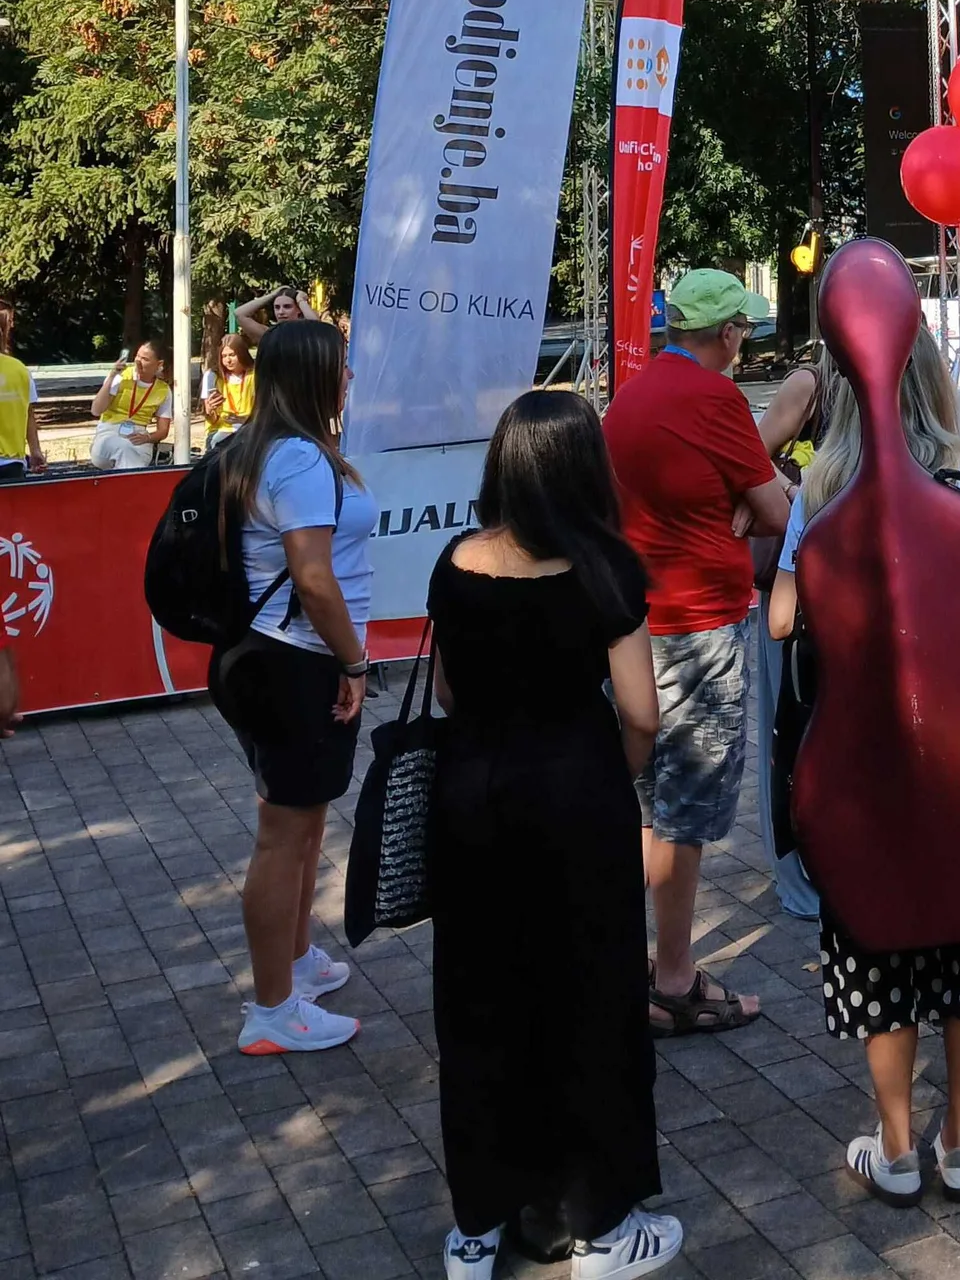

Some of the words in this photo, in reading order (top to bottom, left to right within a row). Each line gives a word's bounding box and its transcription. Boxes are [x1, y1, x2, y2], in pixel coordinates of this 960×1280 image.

[365, 282, 411, 310] VIŠE
[419, 290, 459, 314] OD
[467, 294, 535, 321] KLIKA
